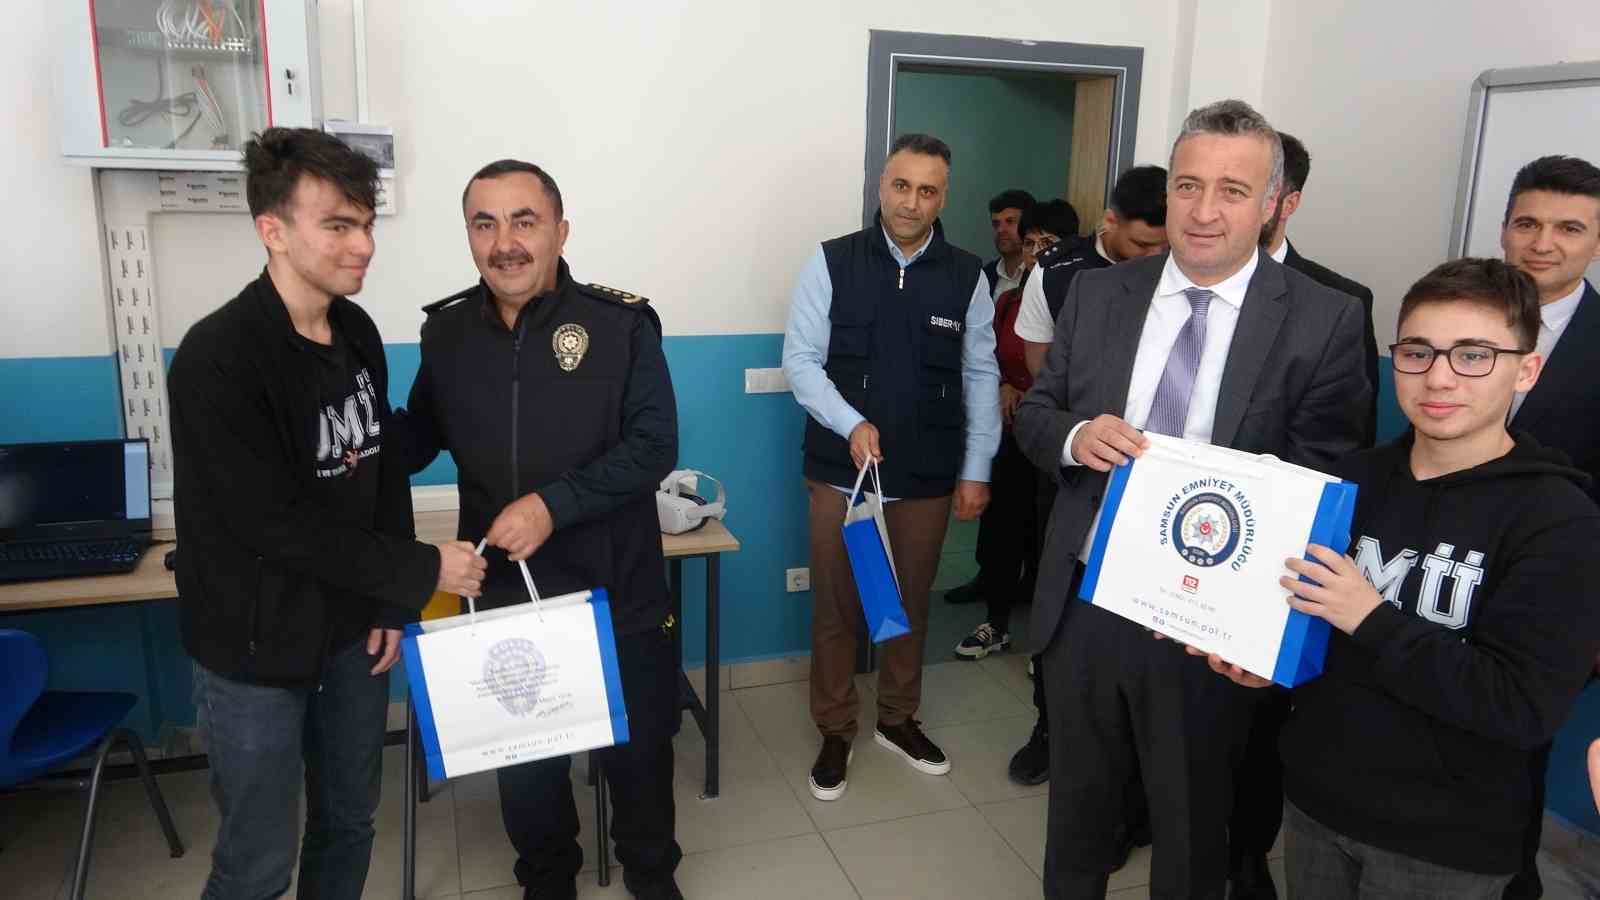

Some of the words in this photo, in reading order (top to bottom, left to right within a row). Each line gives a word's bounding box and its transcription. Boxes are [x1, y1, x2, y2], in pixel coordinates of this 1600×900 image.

[1160, 493, 1181, 545] SAMSUN
[1182, 476, 1235, 495] EMNİYET
[1231, 490, 1256, 572] MÜDÜRLÜĞÜ
